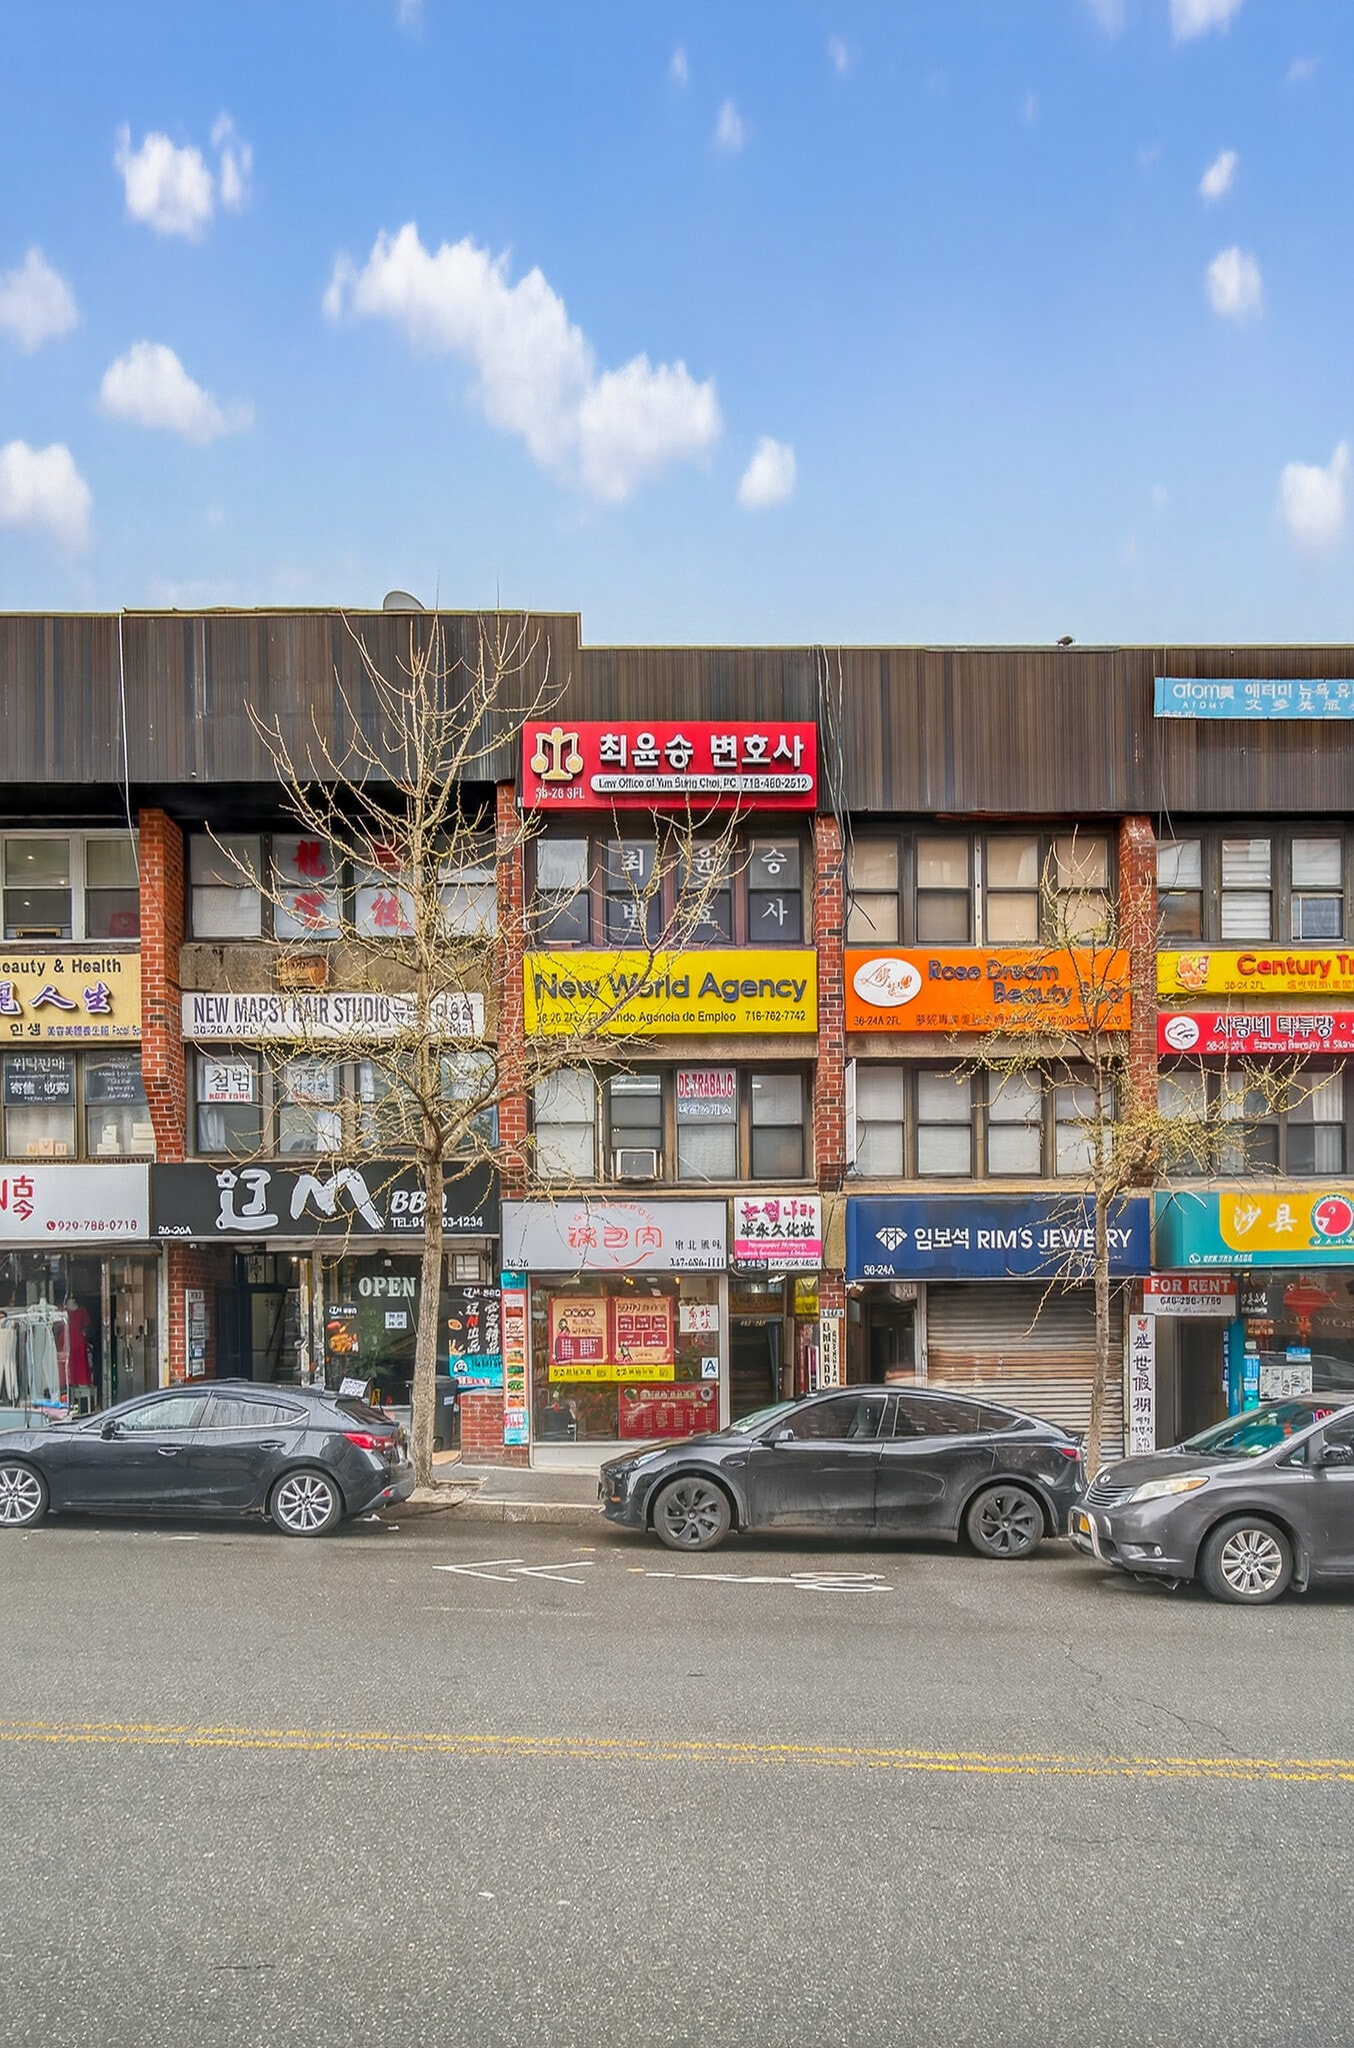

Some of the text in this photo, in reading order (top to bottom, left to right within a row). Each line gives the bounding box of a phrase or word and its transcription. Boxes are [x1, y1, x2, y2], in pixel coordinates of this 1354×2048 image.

[600, 733, 805, 768] 최윤승 변호사
[599, 778, 616, 788] Law
[618, 777, 644, 789] Office
[53, 959, 64, 974] &
[72, 959, 122, 974] Health
[929, 959, 1059, 981] Rose Dream
[1237, 954, 1332, 979] Century
[535, 972, 807, 1003] New World Agency
[194, 997, 229, 1023] NEW
[334, 997, 390, 1023] STUDIO
[698, 1011, 737, 1024] Empleo
[390, 1190, 448, 1214] BB
[913, 1227, 970, 1250] 임보석
[1036, 1228, 1133, 1249] JEWERY
[358, 1276, 417, 1298] OPEN
[1150, 1279, 1231, 1293] FOR RENT
[704, 1359, 717, 1374] A
